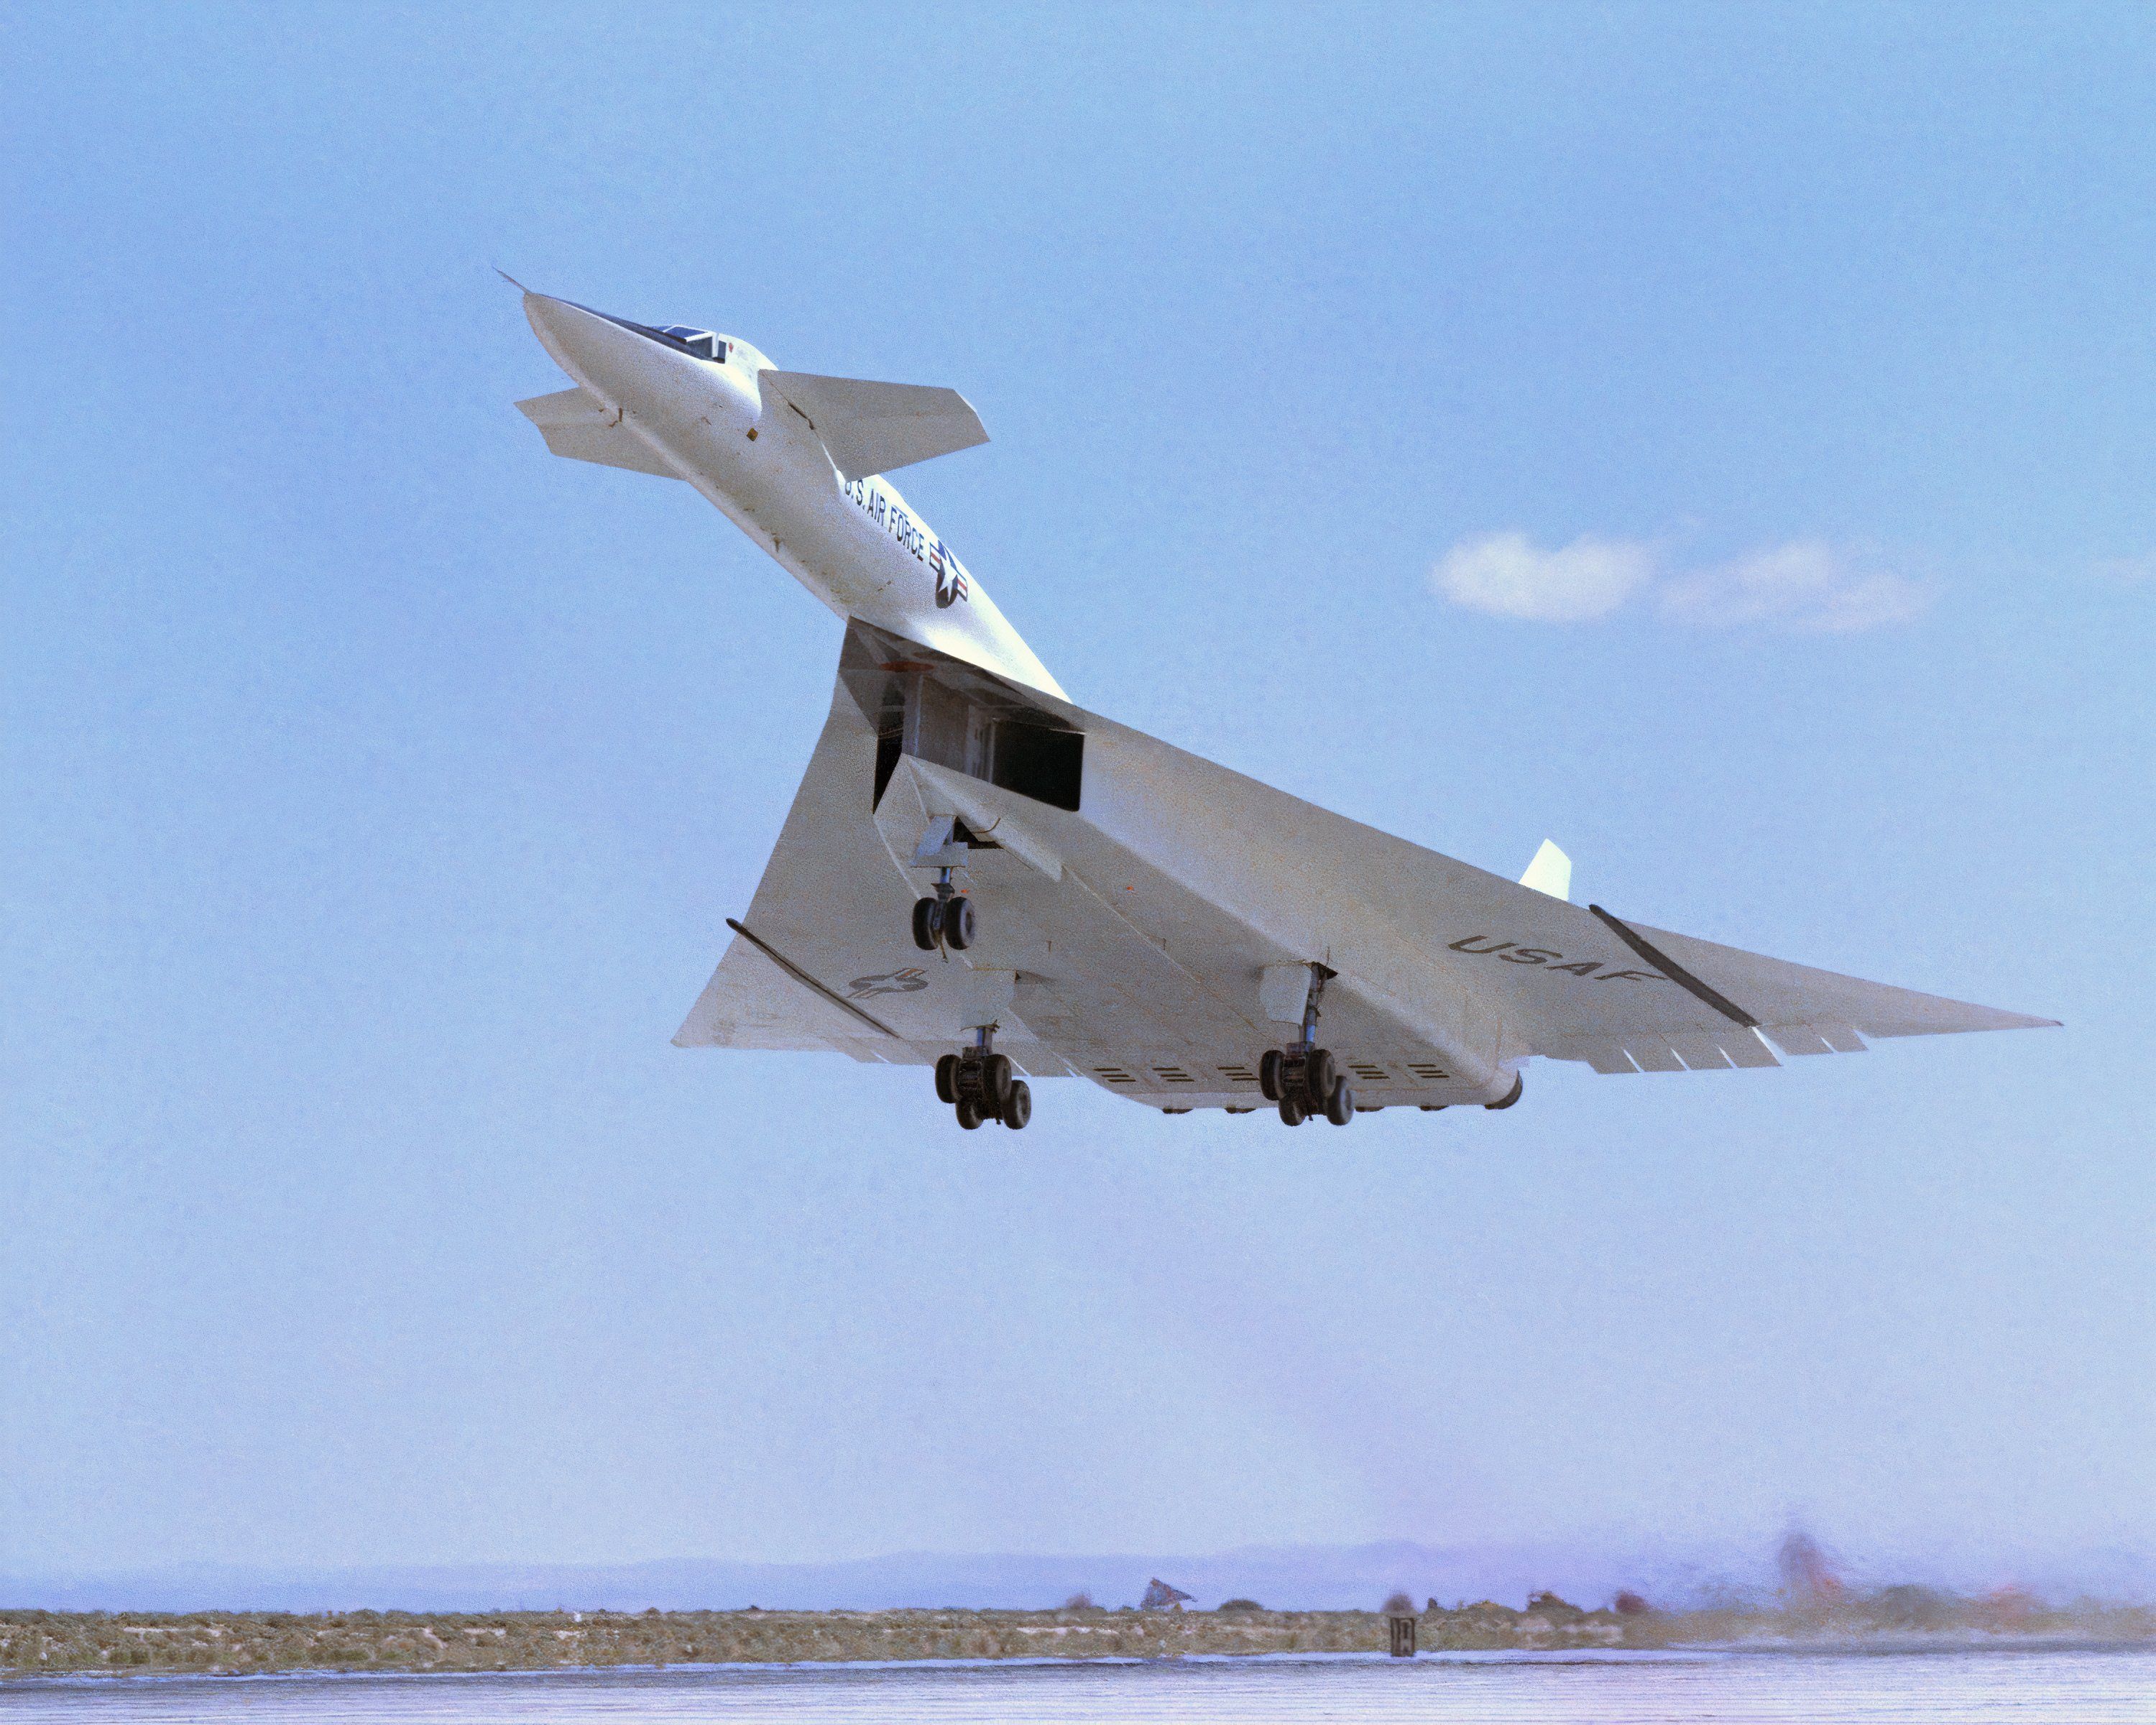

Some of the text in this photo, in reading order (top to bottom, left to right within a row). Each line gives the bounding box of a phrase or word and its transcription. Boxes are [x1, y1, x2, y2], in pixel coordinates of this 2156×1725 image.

[867, 489, 885, 526] AIR
[888, 506, 924, 561] FORCE
[1447, 935, 1669, 981] USAF
